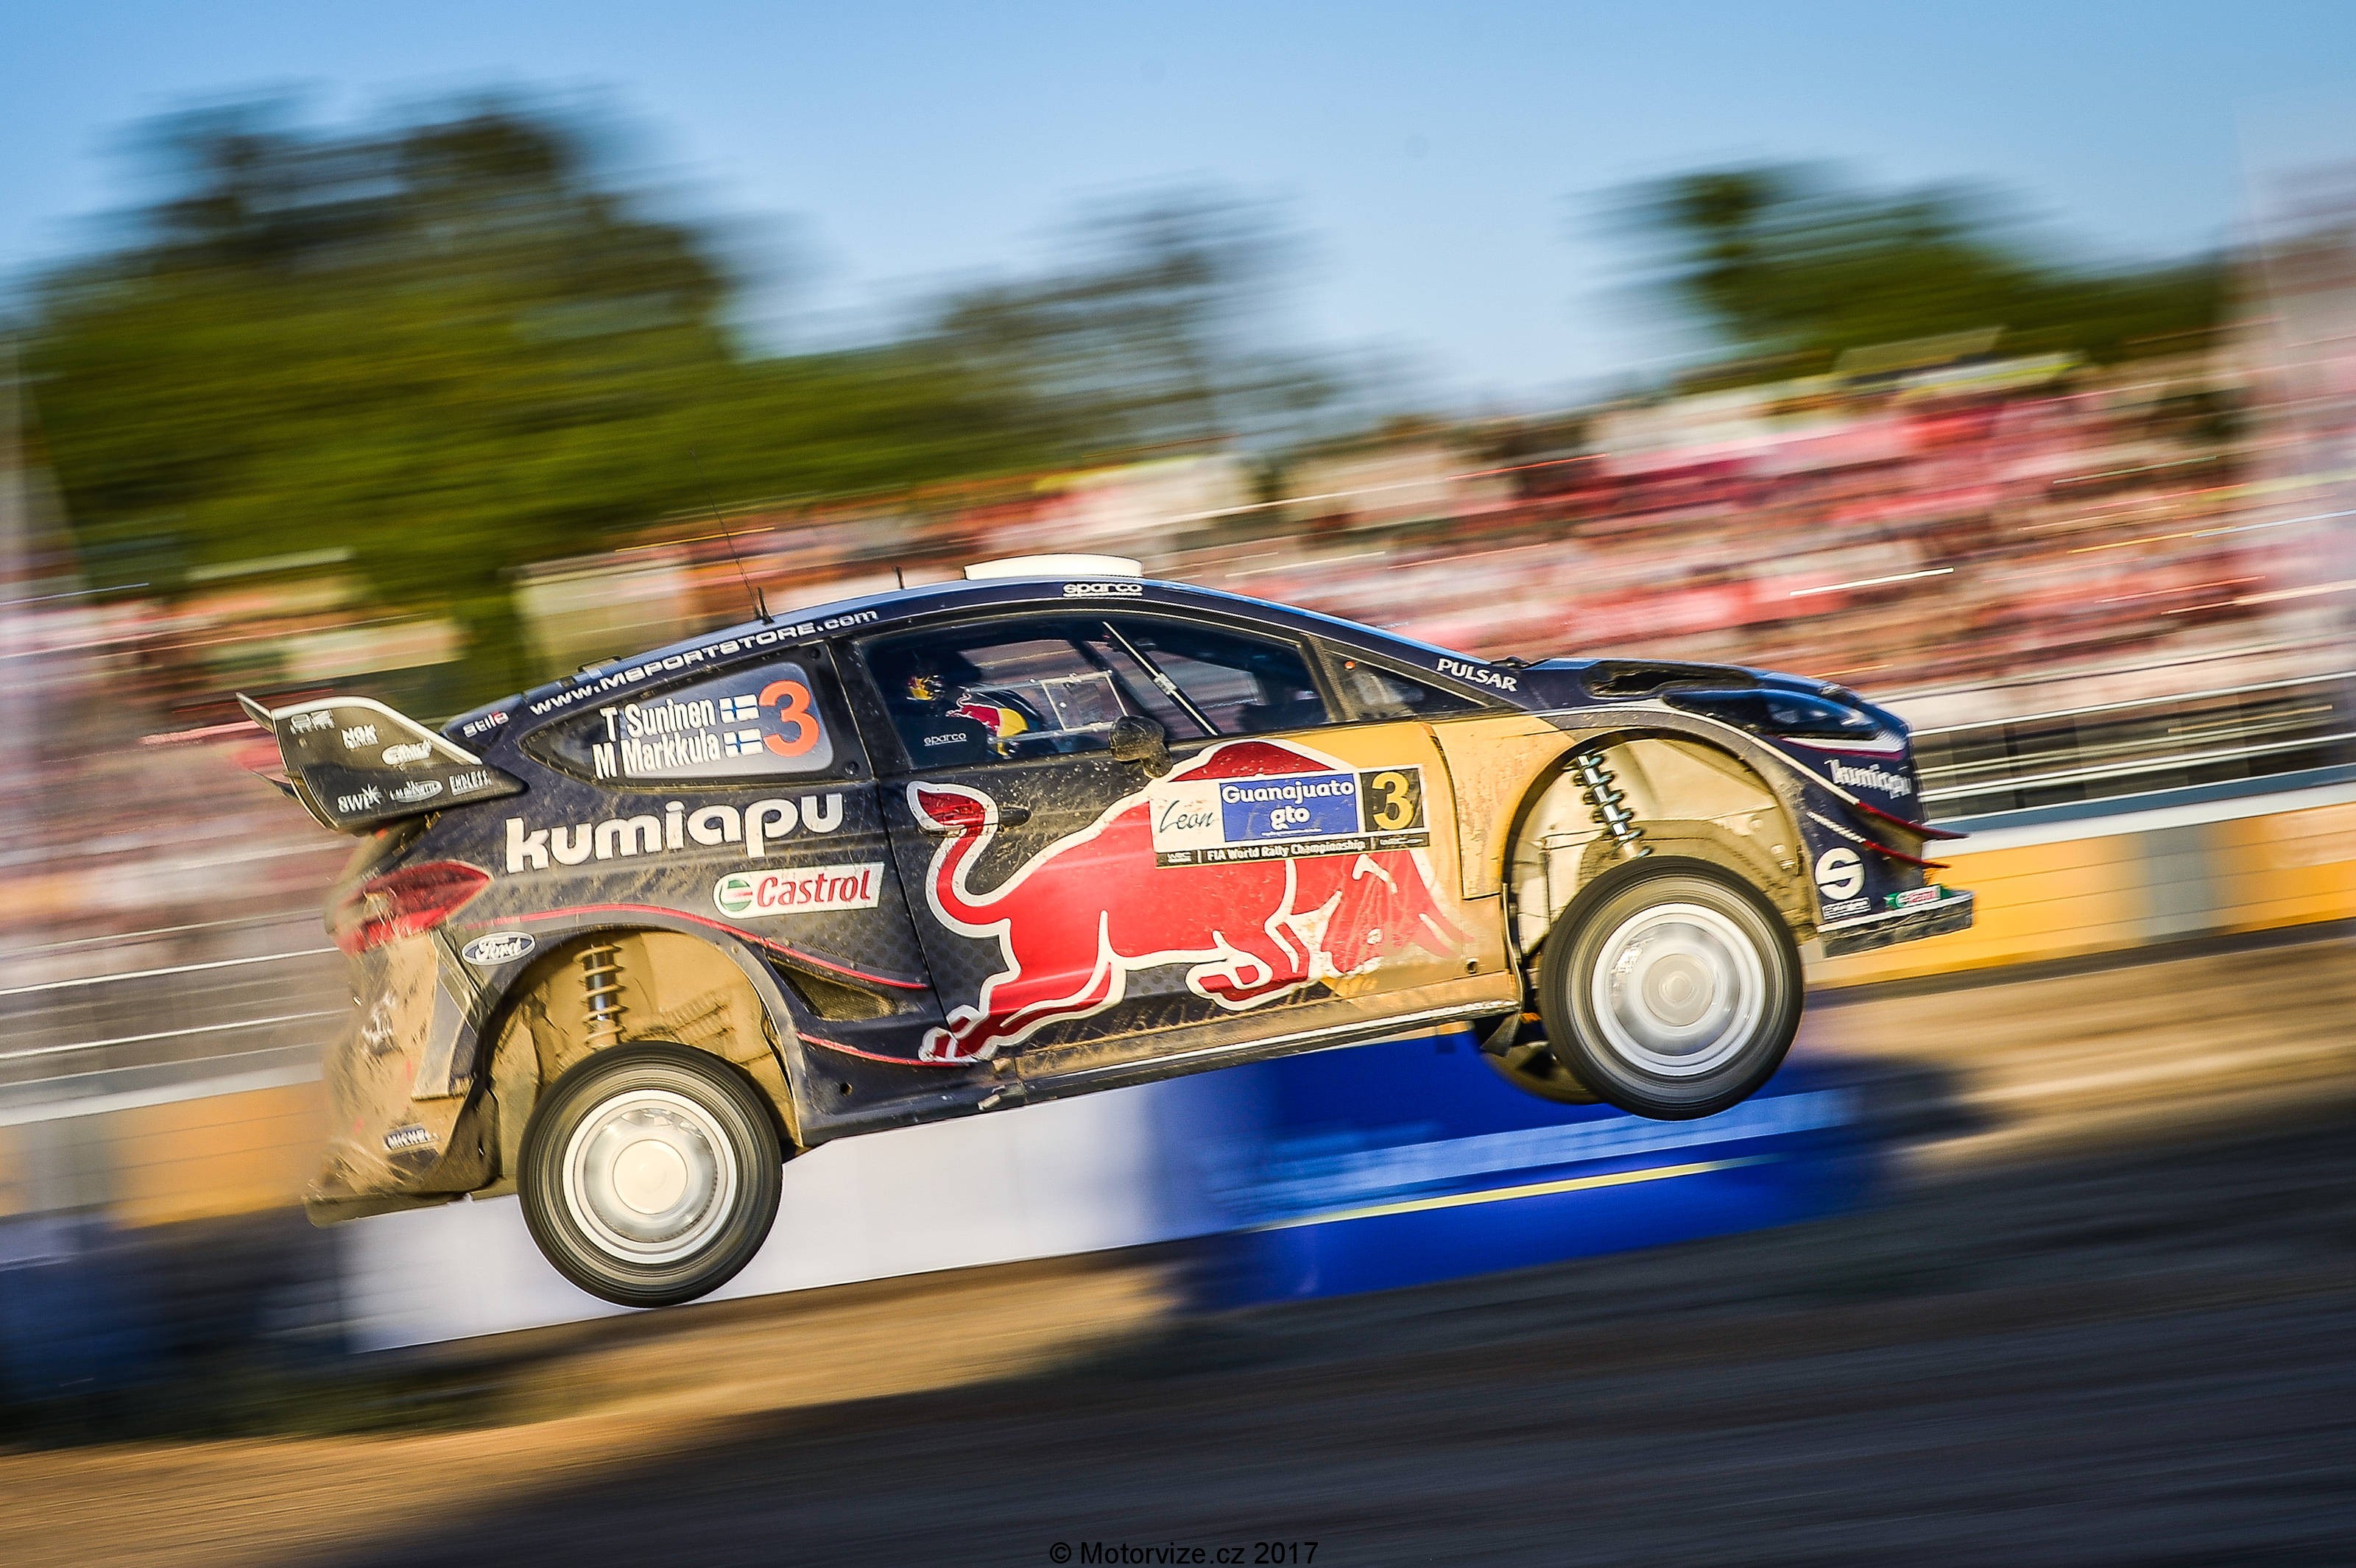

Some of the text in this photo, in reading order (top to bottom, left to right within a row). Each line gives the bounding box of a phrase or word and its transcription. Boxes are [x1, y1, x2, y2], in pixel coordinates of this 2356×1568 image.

[1062, 583, 1143, 597] sparco
[1436, 657, 1517, 691] PULSAR
[599, 698, 716, 740] T Suninen
[758, 679, 820, 757] 3
[593, 731, 722, 780] M Markkula
[1221, 780, 1354, 804] Guanajuato
[1371, 771, 1414, 830] 3
[506, 792, 844, 873] kumiapu
[1269, 805, 1311, 829] gto
[1207, 850, 1227, 862] FIA
[1227, 846, 1260, 860] World
[1260, 844, 1289, 858] Rally
[1290, 839, 1366, 855] Championship
[757, 869, 871, 908] Castrol
[475, 937, 522, 963] Ford
